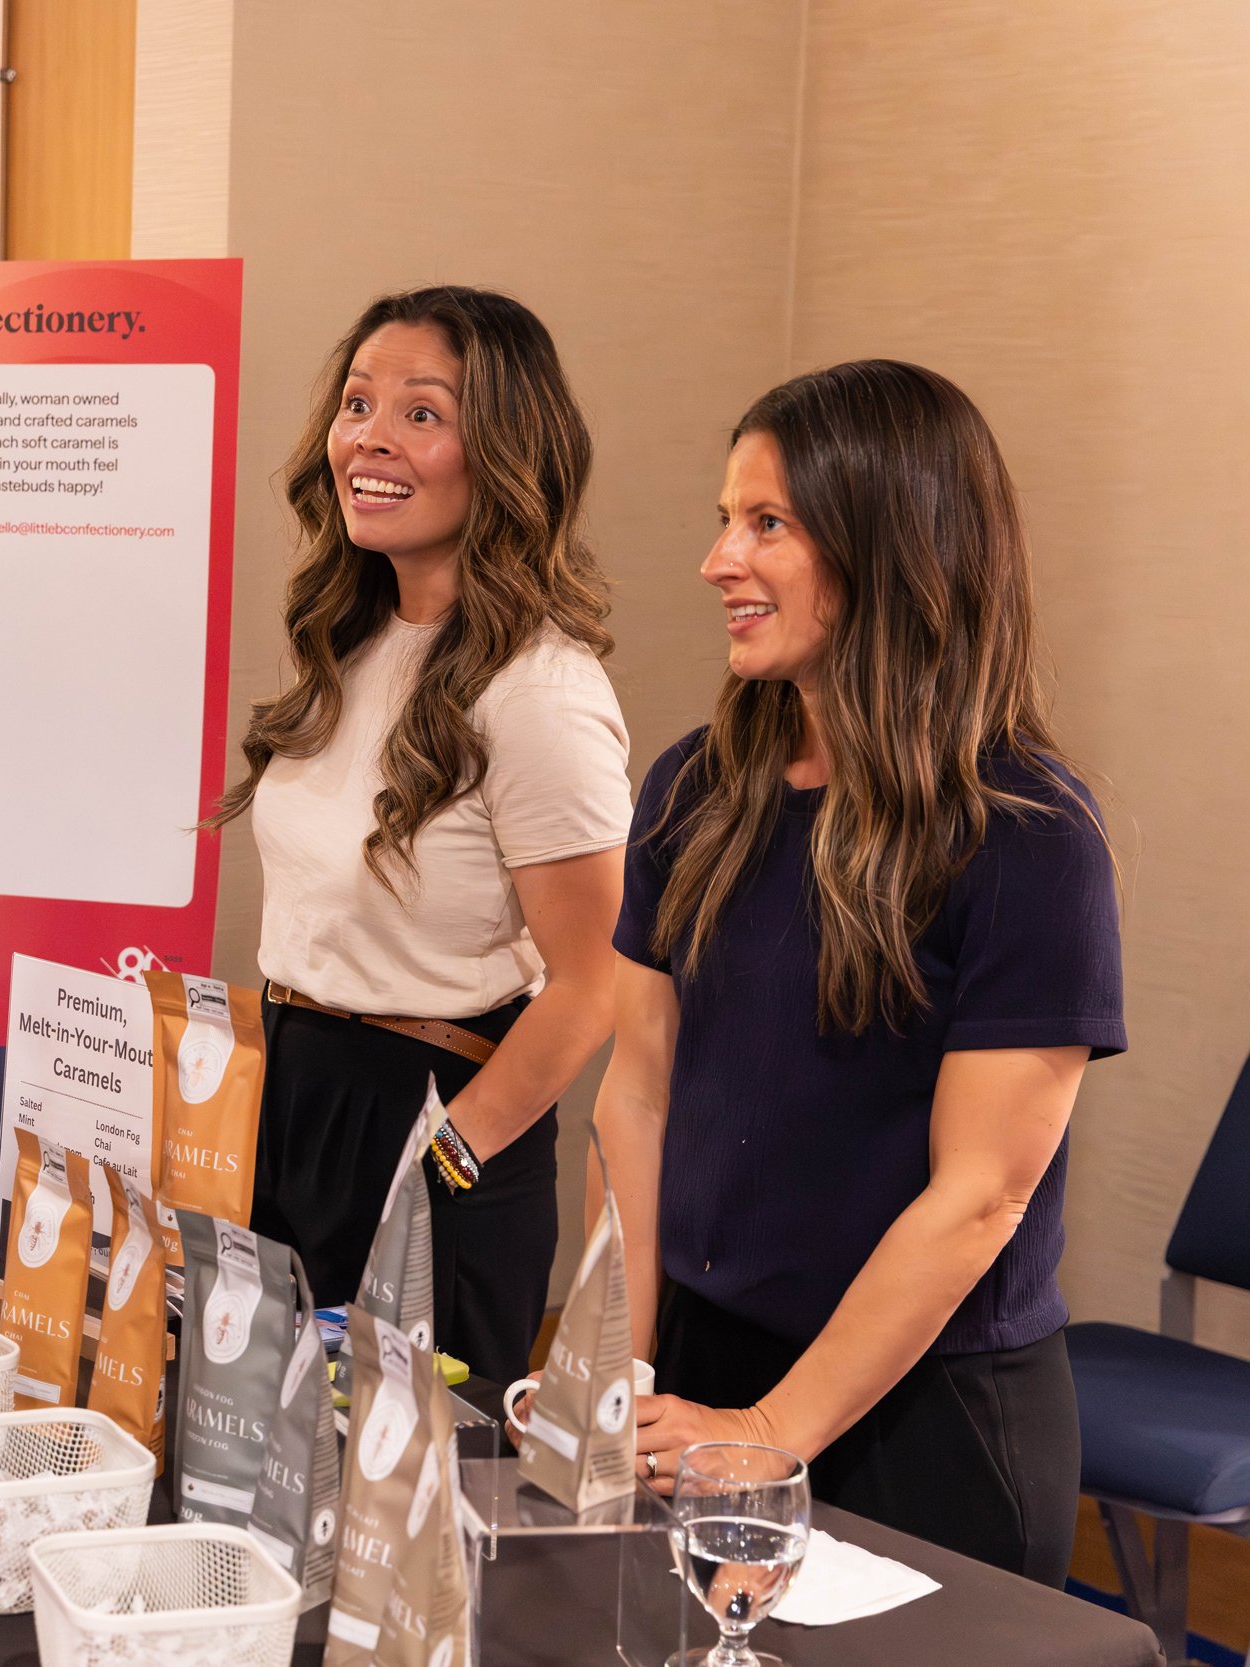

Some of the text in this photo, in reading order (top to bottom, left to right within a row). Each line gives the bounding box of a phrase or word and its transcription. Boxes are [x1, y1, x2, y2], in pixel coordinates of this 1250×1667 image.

[19, 394, 69, 406] woman
[72, 391, 119, 406] owned
[23, 413, 72, 428] crafted
[75, 413, 137, 429] caramels
[21, 434, 47, 449] soft
[50, 435, 105, 450] caramel
[108, 436, 118, 450] is
[12, 460, 42, 474] your
[45, 457, 90, 472] mouth
[92, 457, 118, 472] feel
[57, 479, 103, 497] happy!
[57, 987, 127, 1028] Premium,
[19, 1012, 153, 1068] Melt-in-Your-Mout
[53, 1057, 122, 1094] Caramels
[19, 1096, 43, 1112] Salted
[18, 1113, 35, 1127] Mint
[95, 1119, 141, 1145] London Fog
[94, 1137, 112, 1151] Chai
[123, 1164, 138, 1178] Lait
[14, 1289, 30, 1300] CHAI
[1, 1301, 71, 1339] RAMELS
[4, 1330, 23, 1342] CHAI
